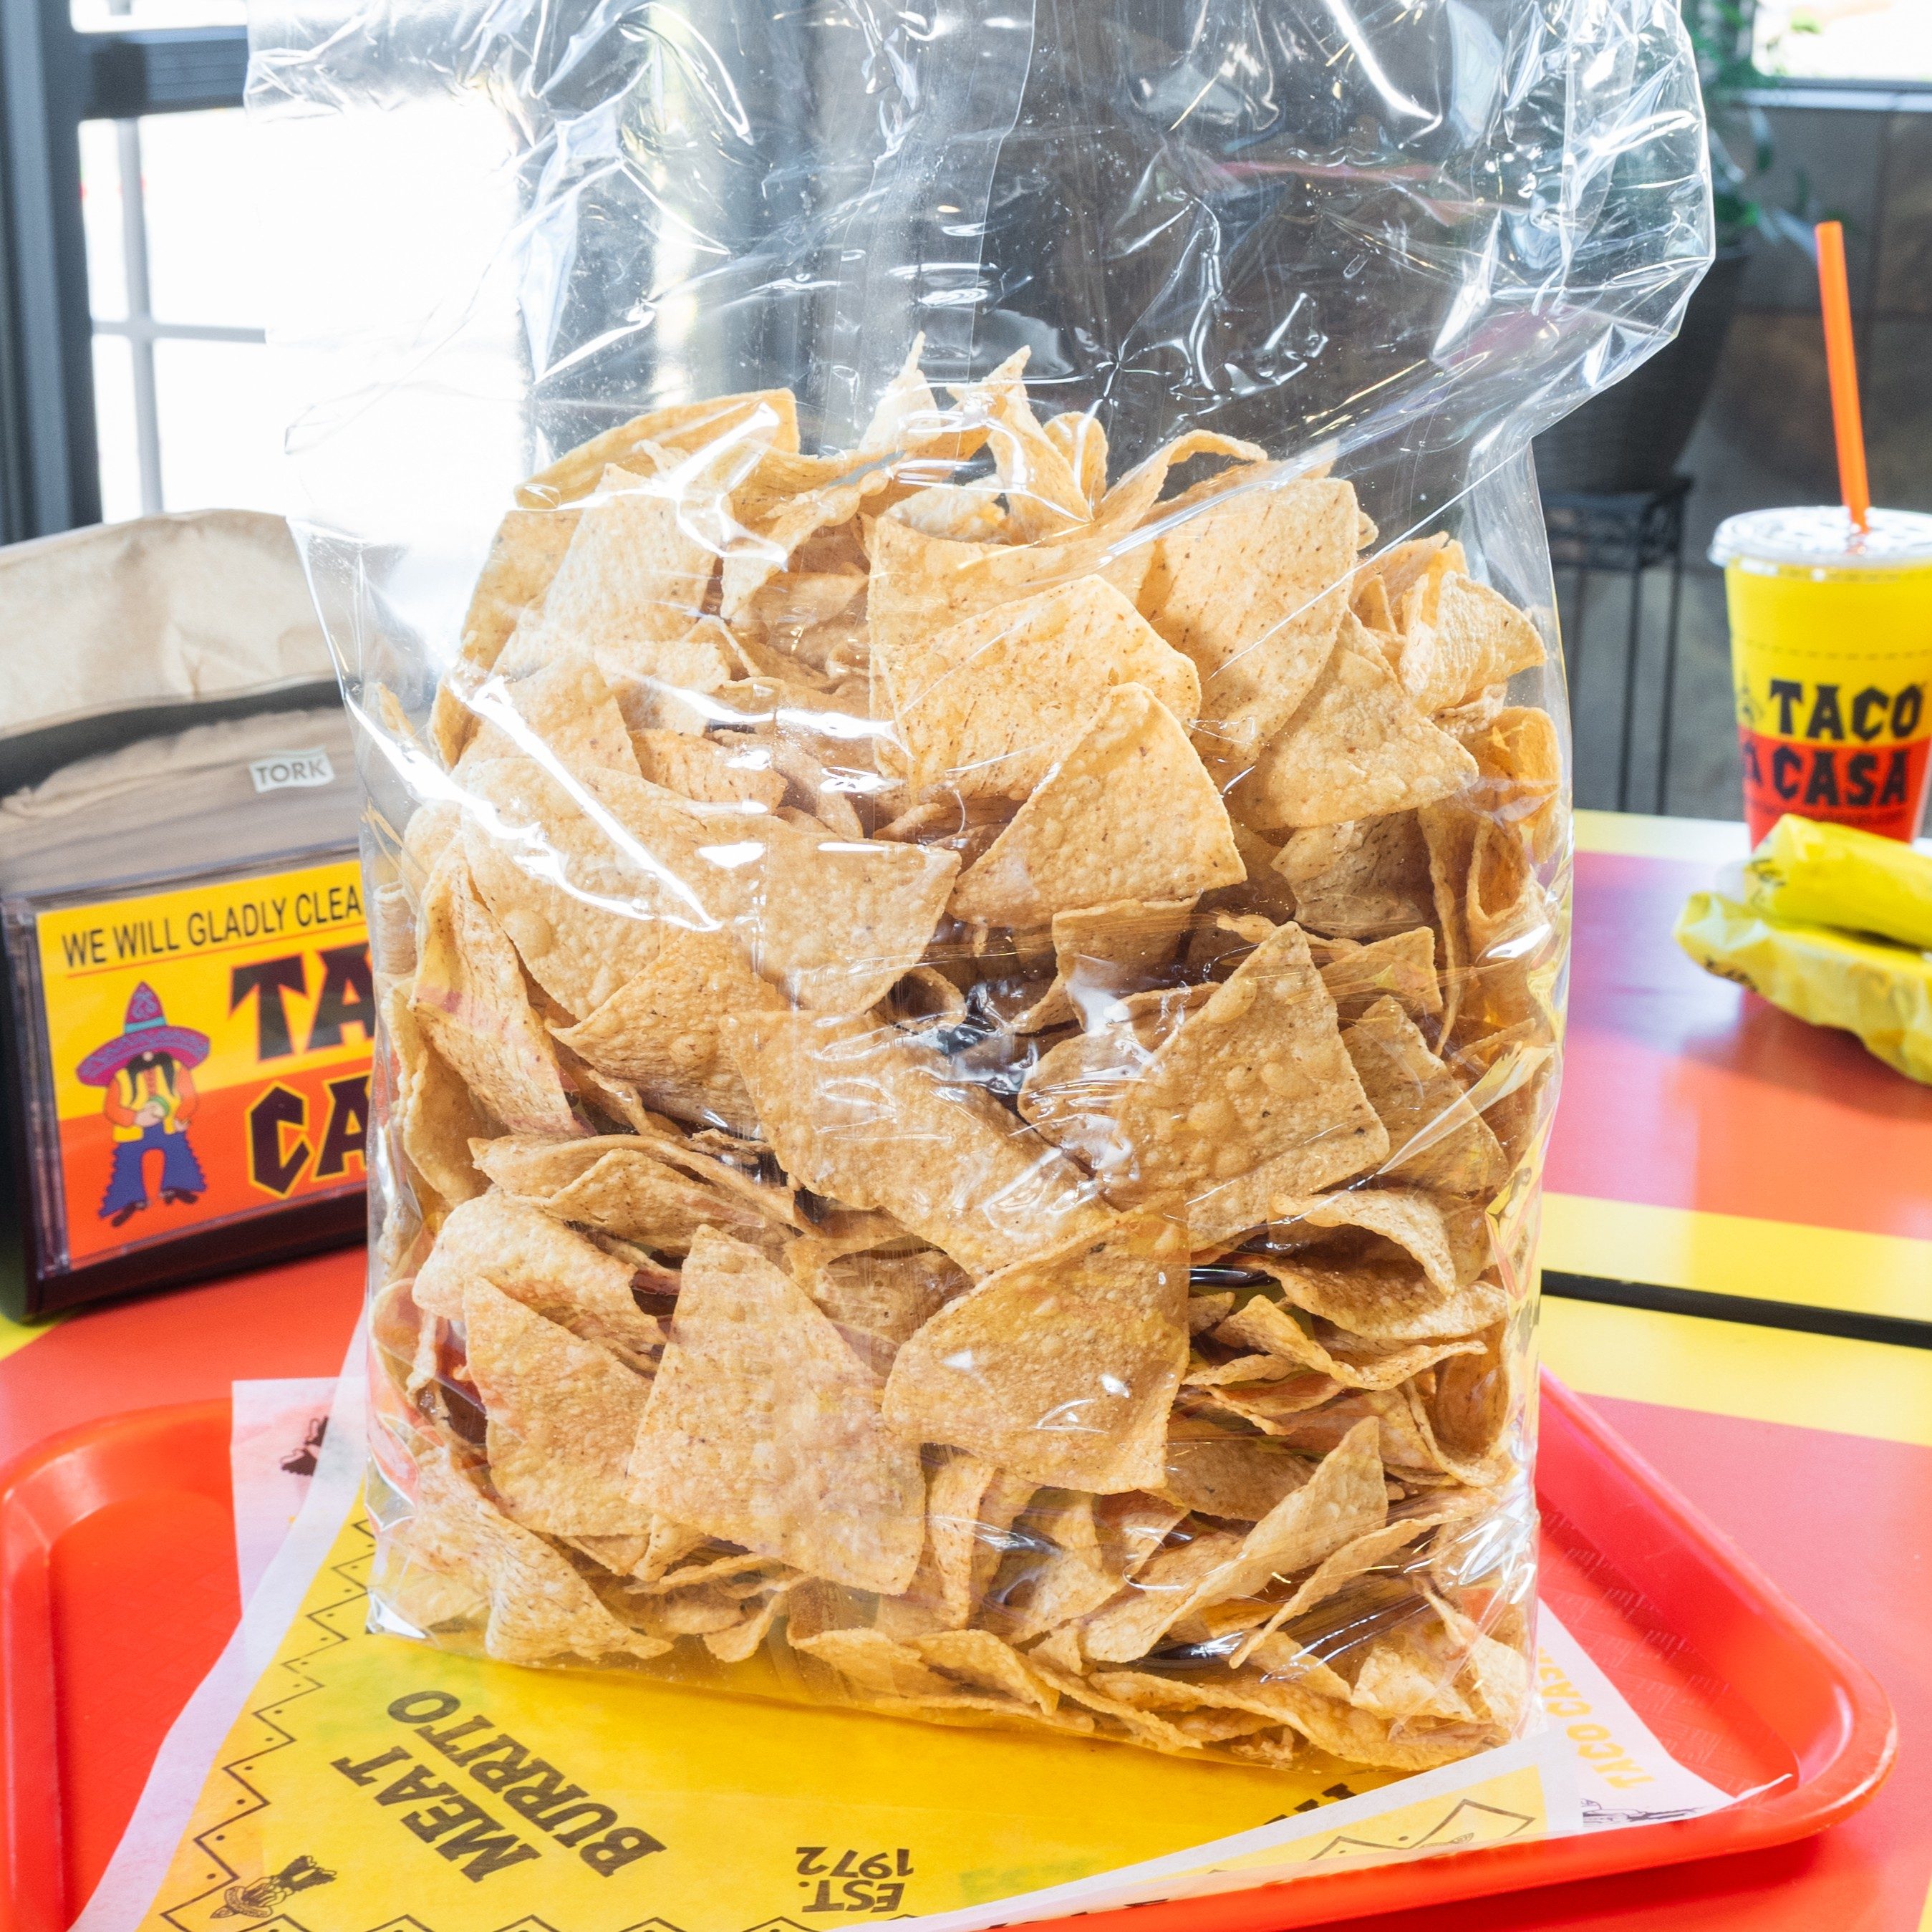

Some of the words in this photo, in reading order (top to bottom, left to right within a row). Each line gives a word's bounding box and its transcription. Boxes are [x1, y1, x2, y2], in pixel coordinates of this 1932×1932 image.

[1769, 678, 1923, 741] TACO
[256, 759, 327, 784] TORK
[1772, 745, 1911, 807] CASA
[61, 929, 107, 967] WE
[112, 918, 180, 958] WILL
[188, 897, 287, 946] GLADLY
[295, 884, 362, 927] CLEA
[229, 942, 377, 1063] TA
[248, 1073, 369, 1197] CA
[387, 1690, 667, 1878] BURRITO
[1565, 1723, 1656, 1789] TACO
[329, 1745, 543, 1884] MEAT
[796, 1846, 914, 1880] 1972
[798, 1879, 905, 1913] EST.
